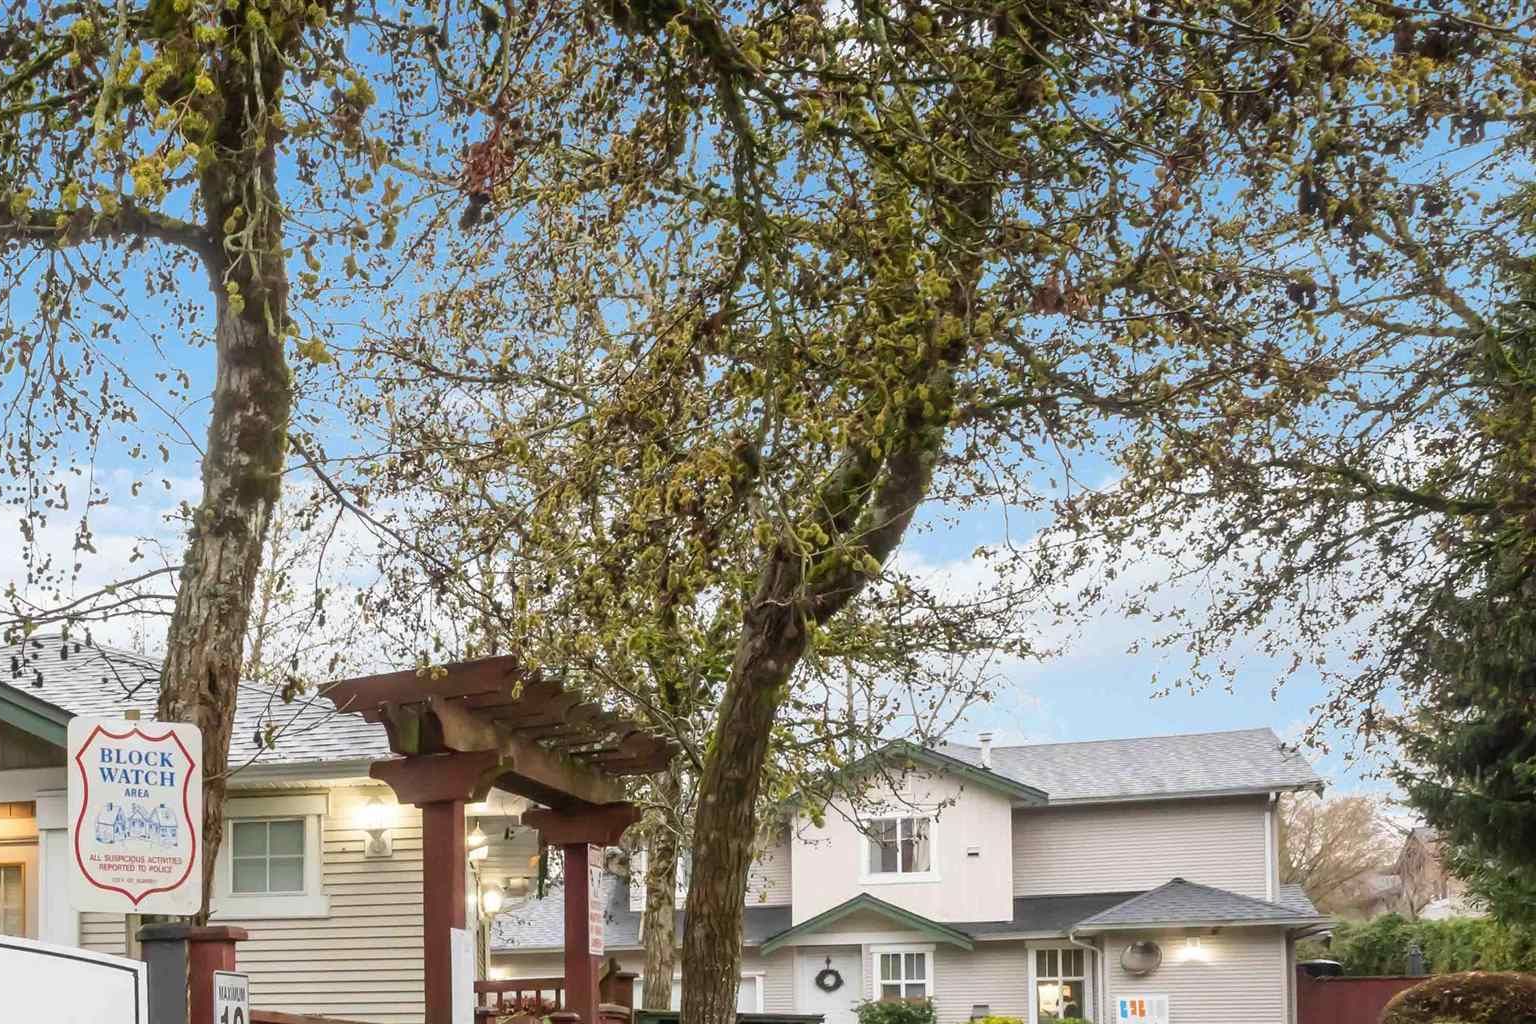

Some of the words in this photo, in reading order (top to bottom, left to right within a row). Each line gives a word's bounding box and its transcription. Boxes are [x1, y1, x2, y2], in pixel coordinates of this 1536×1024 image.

[99, 747, 174, 768] BLOCK
[99, 767, 176, 787] WATCH
[124, 788, 150, 799] AREA
[89, 854, 102, 862] ALL
[104, 854, 145, 864] SUSPICIOUS
[147, 856, 183, 865] ACTIVITIES
[99, 863, 136, 872] REPORTED
[138, 865, 147, 873] TO
[218, 985, 246, 1002] MAXIMUM
